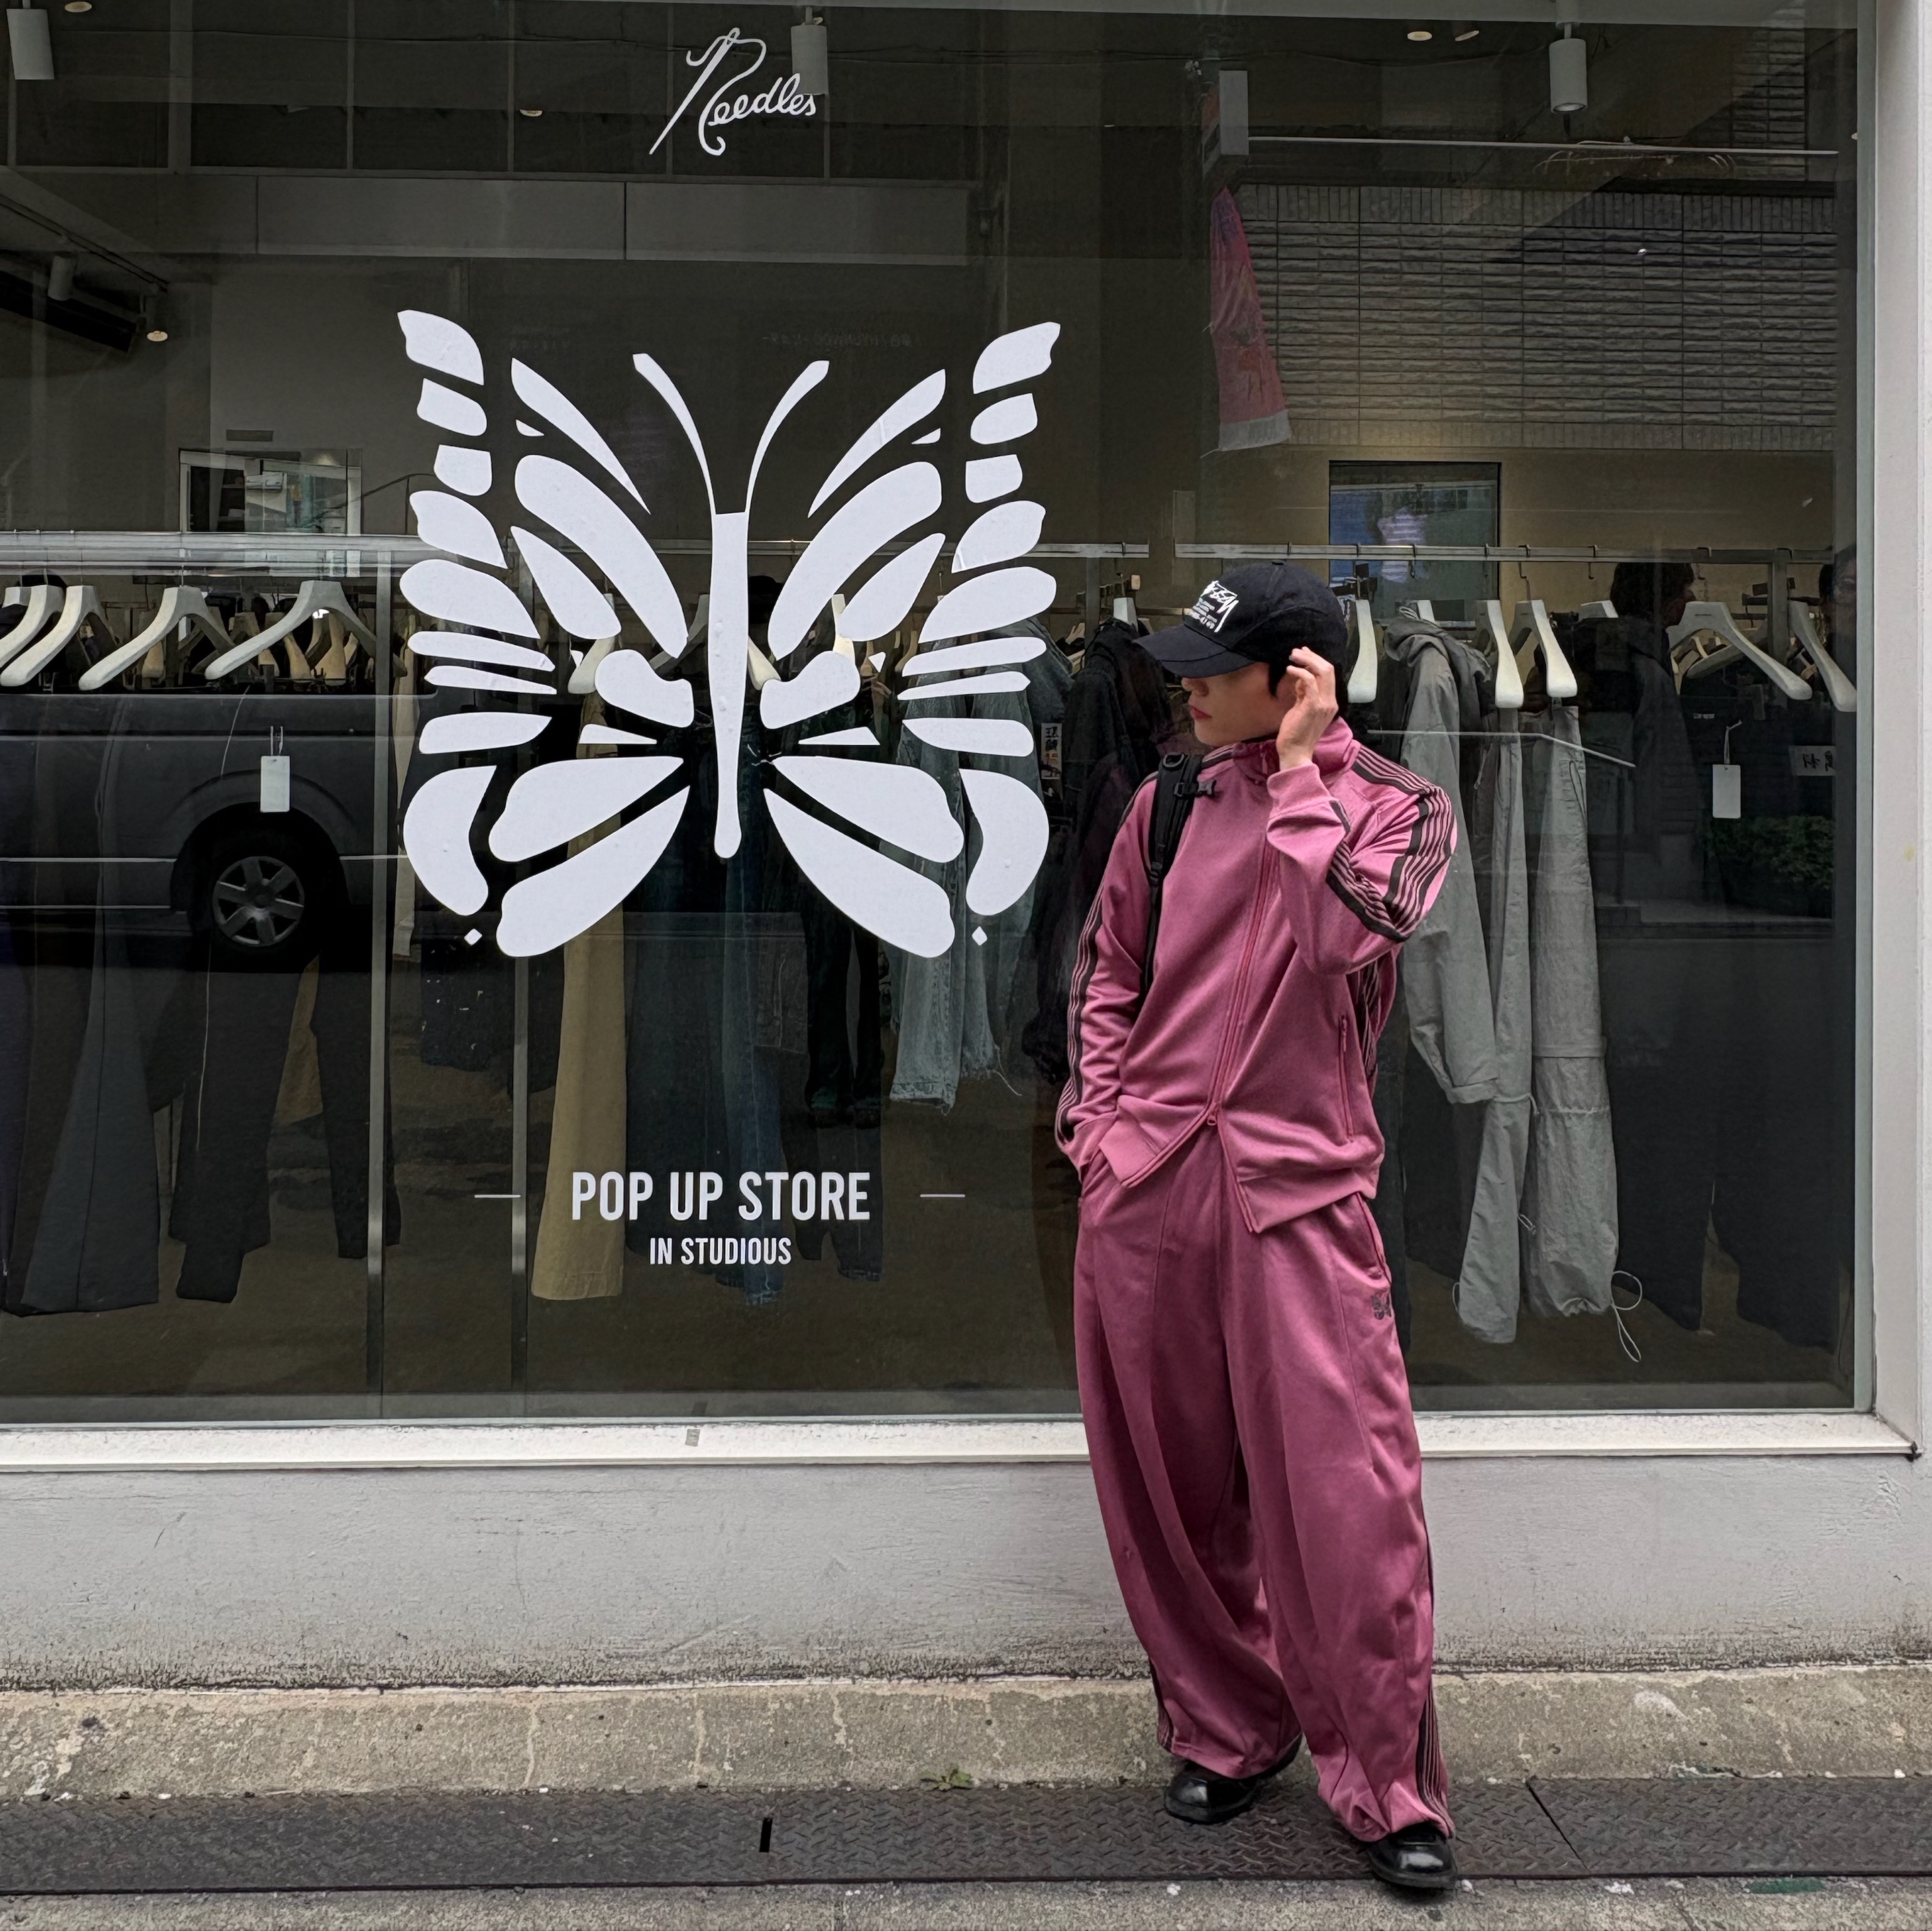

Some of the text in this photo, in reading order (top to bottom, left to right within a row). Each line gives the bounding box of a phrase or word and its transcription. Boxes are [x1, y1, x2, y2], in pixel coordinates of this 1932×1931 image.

[649, 27, 816, 156] Needles
[572, 1171, 871, 1221] POP UP STORE
[650, 1237, 792, 1265] IN STUDIOUS
